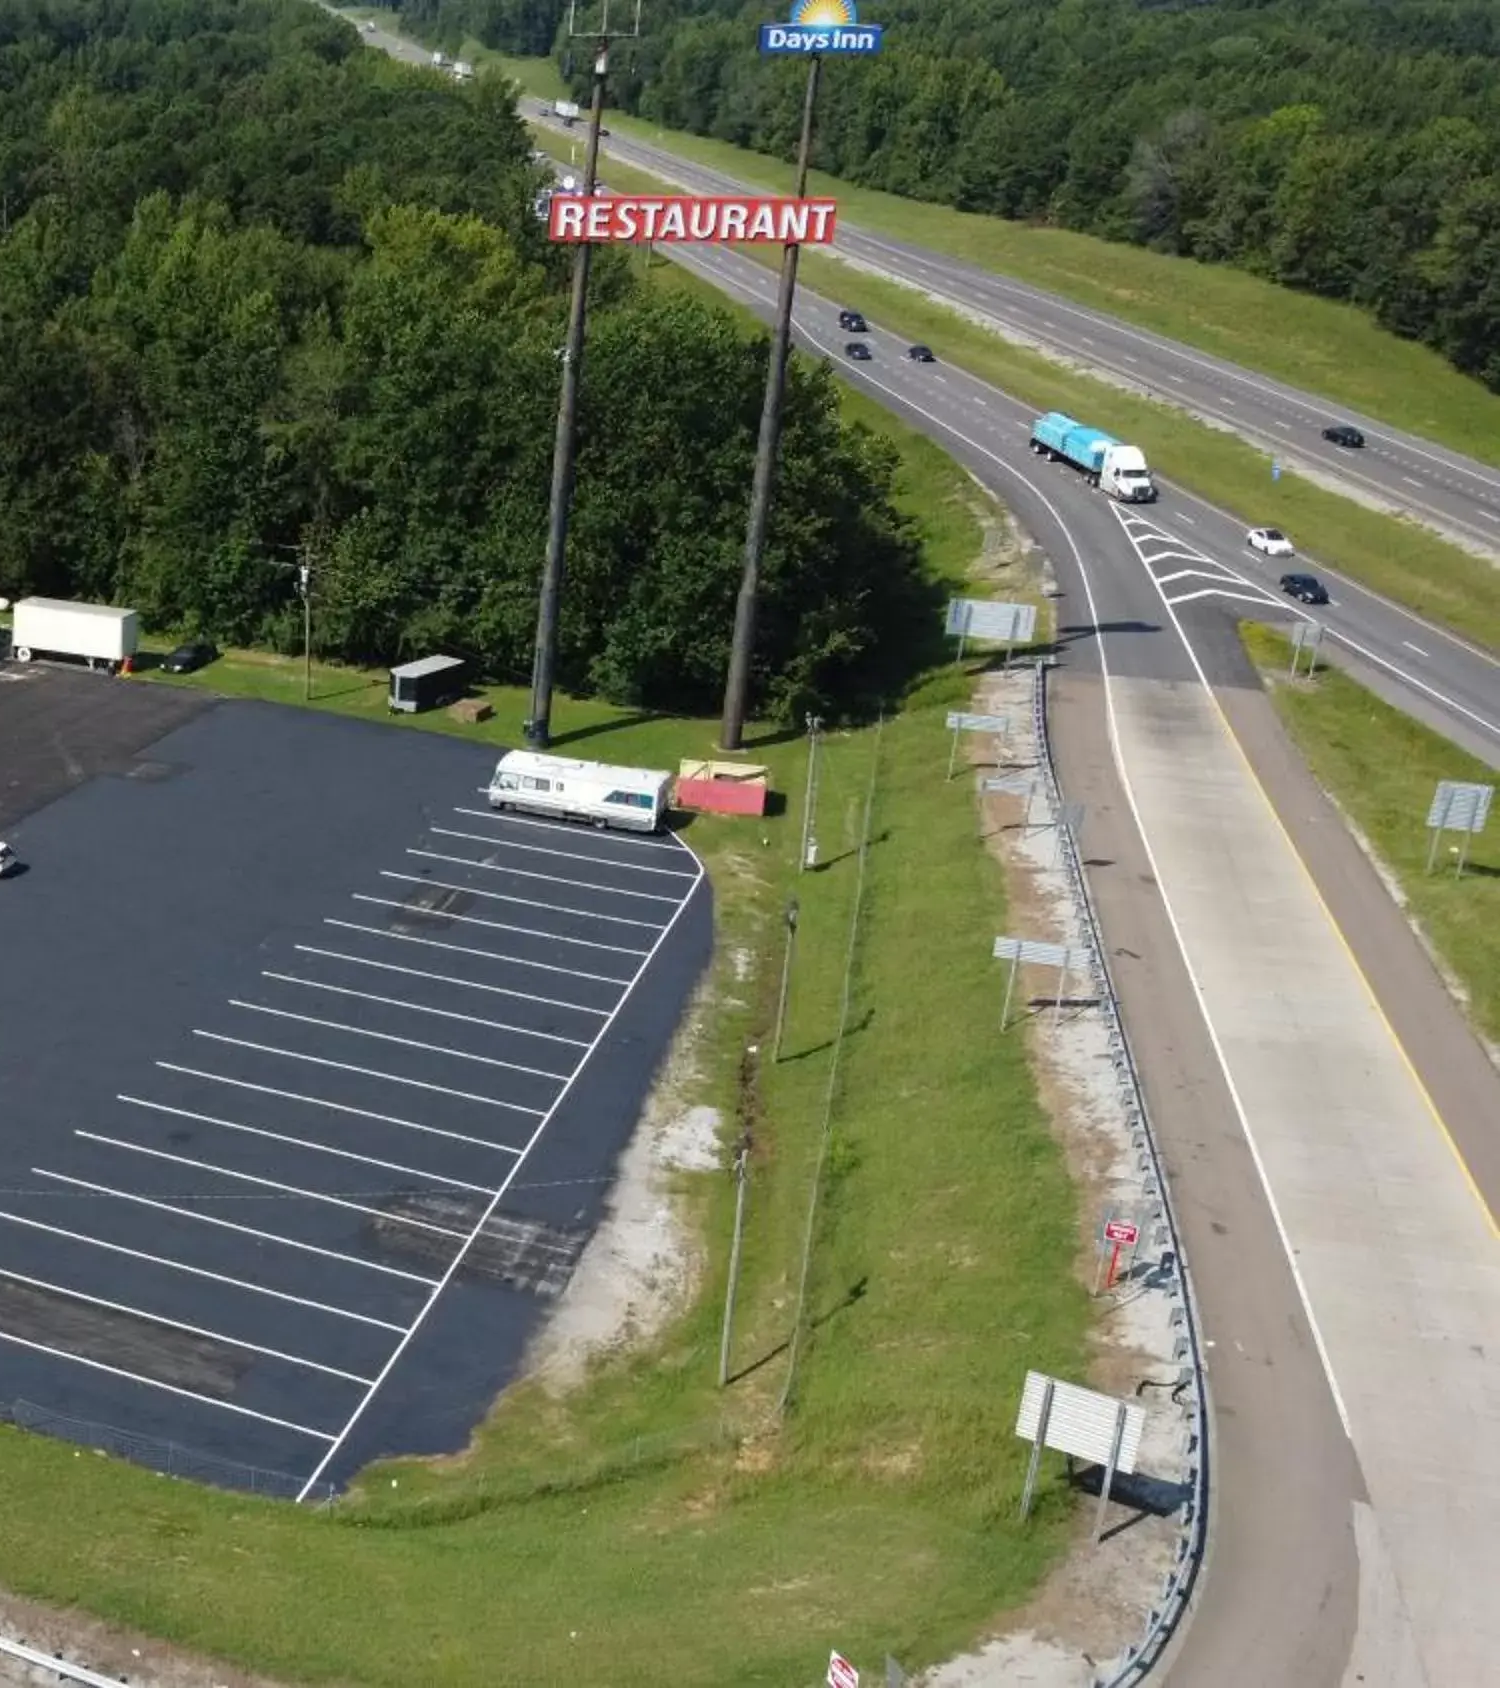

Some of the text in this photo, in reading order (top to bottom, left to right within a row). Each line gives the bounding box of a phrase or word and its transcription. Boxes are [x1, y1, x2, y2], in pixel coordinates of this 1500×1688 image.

[768, 28, 874, 51] Days Inn
[555, 200, 836, 241] RESTAURANT
